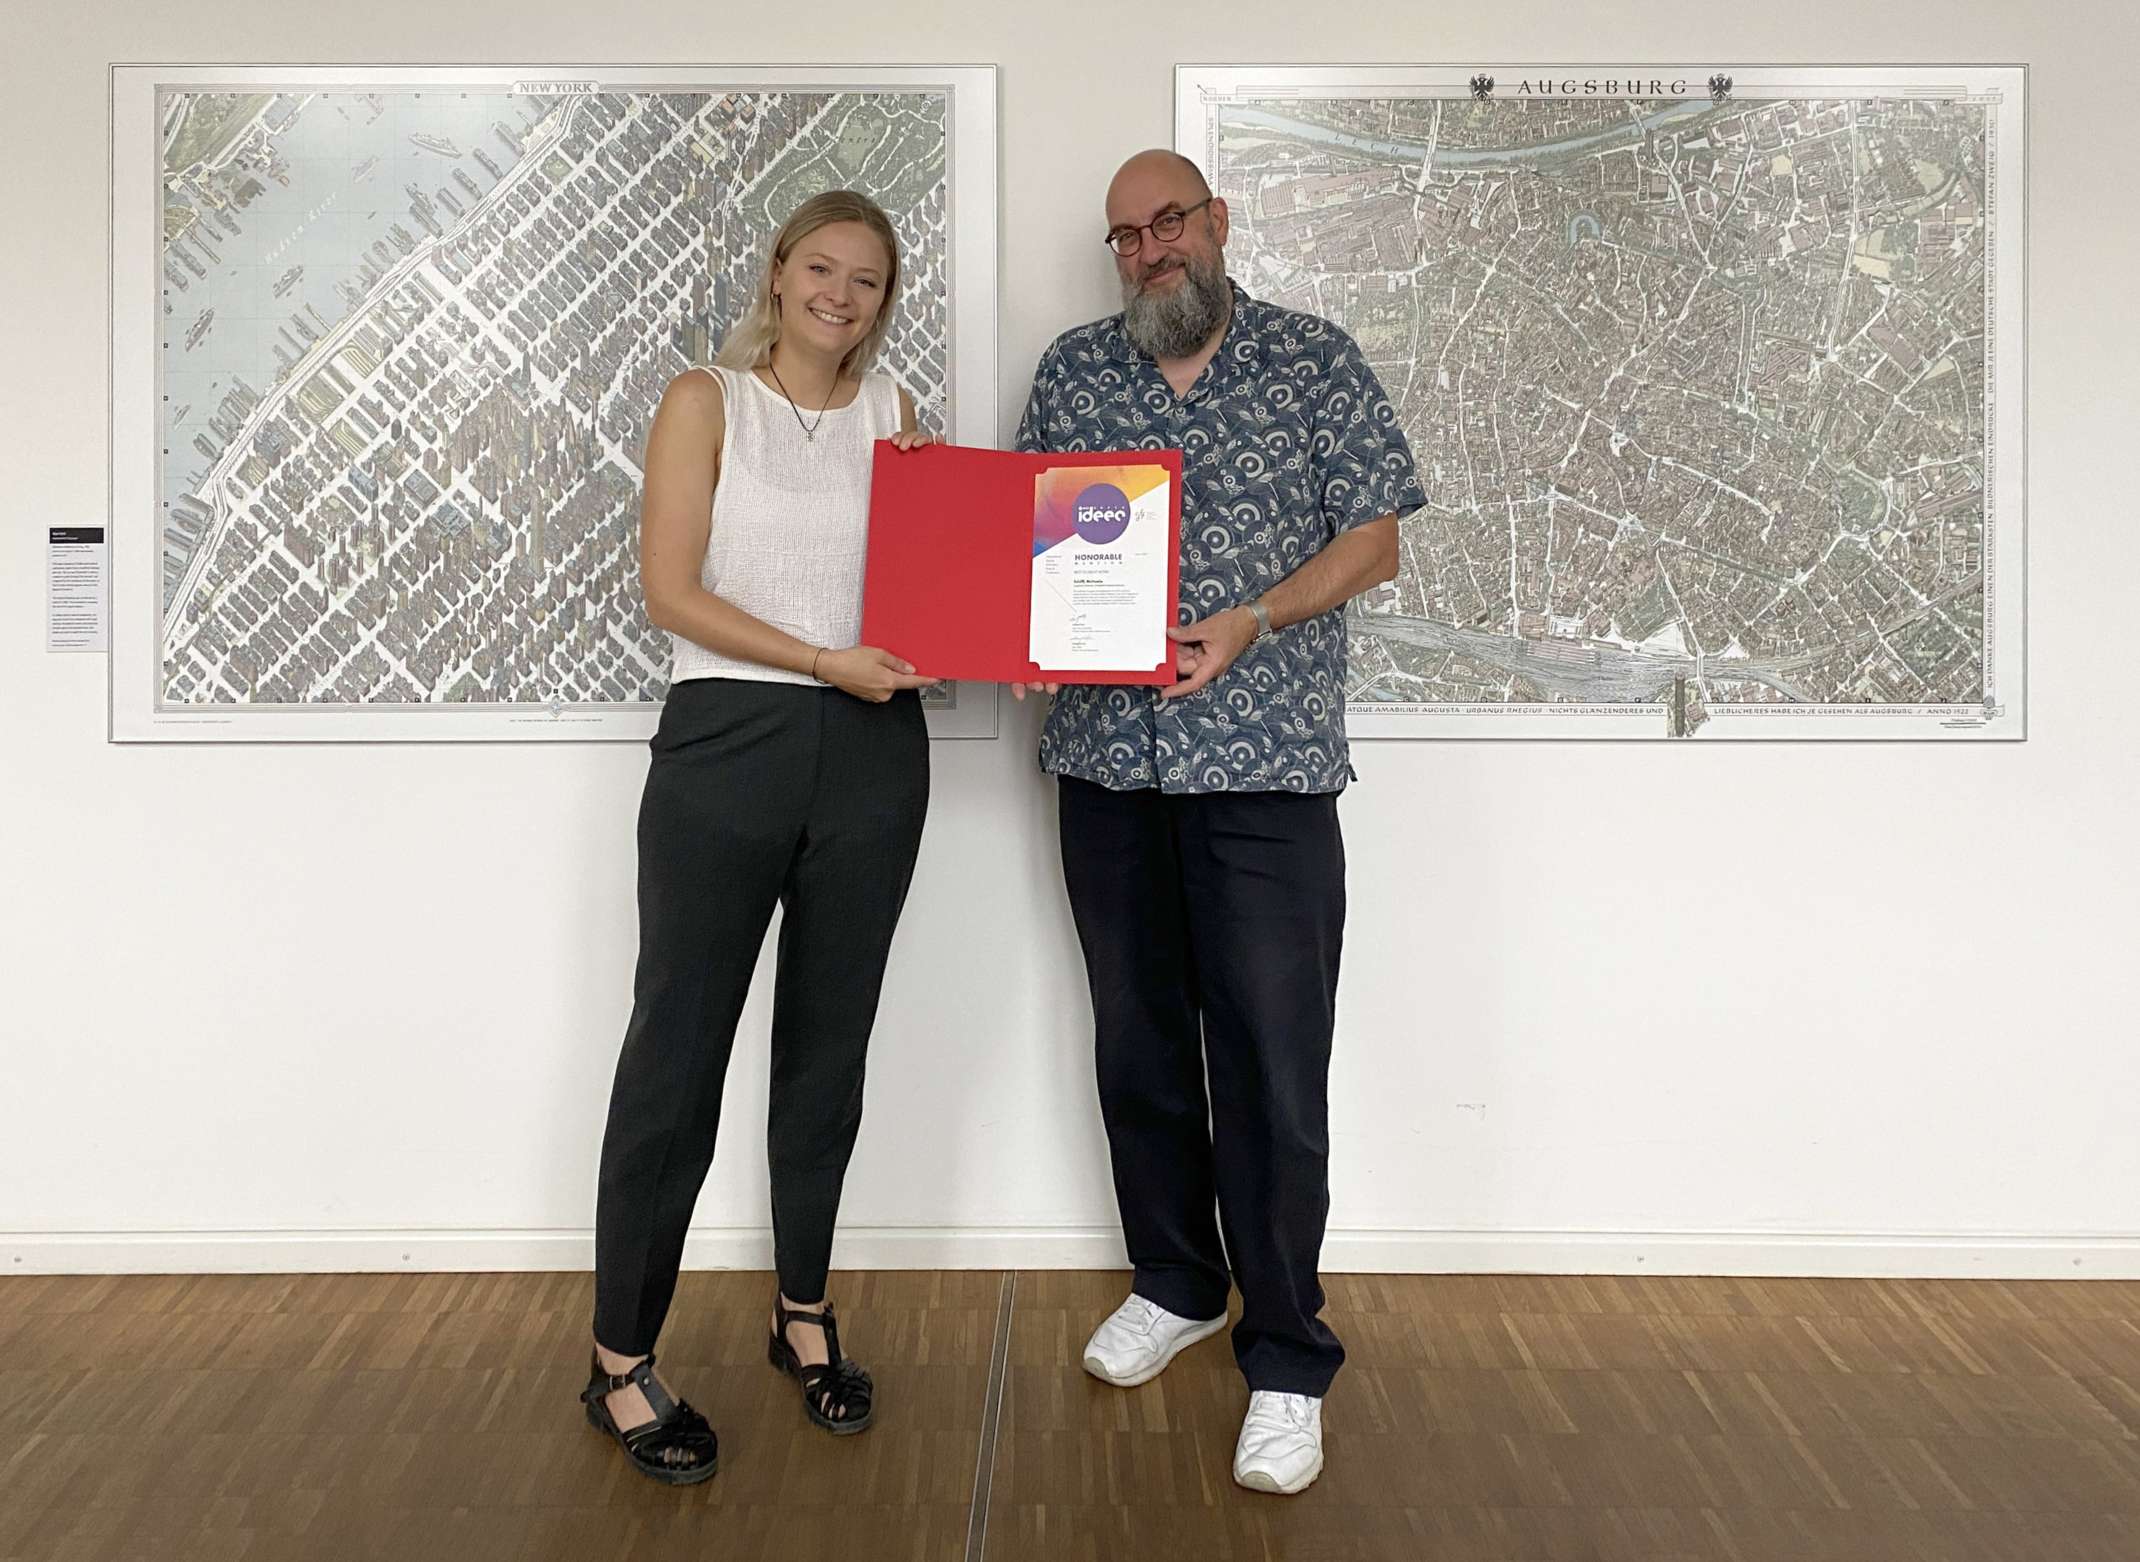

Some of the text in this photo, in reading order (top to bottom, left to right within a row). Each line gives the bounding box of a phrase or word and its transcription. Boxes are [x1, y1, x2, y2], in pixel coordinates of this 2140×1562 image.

[520, 83, 593, 93] NEW YORK
[1518, 79, 1687, 94] AUGSBURG
[1074, 553, 1123, 561] HONORABLE
